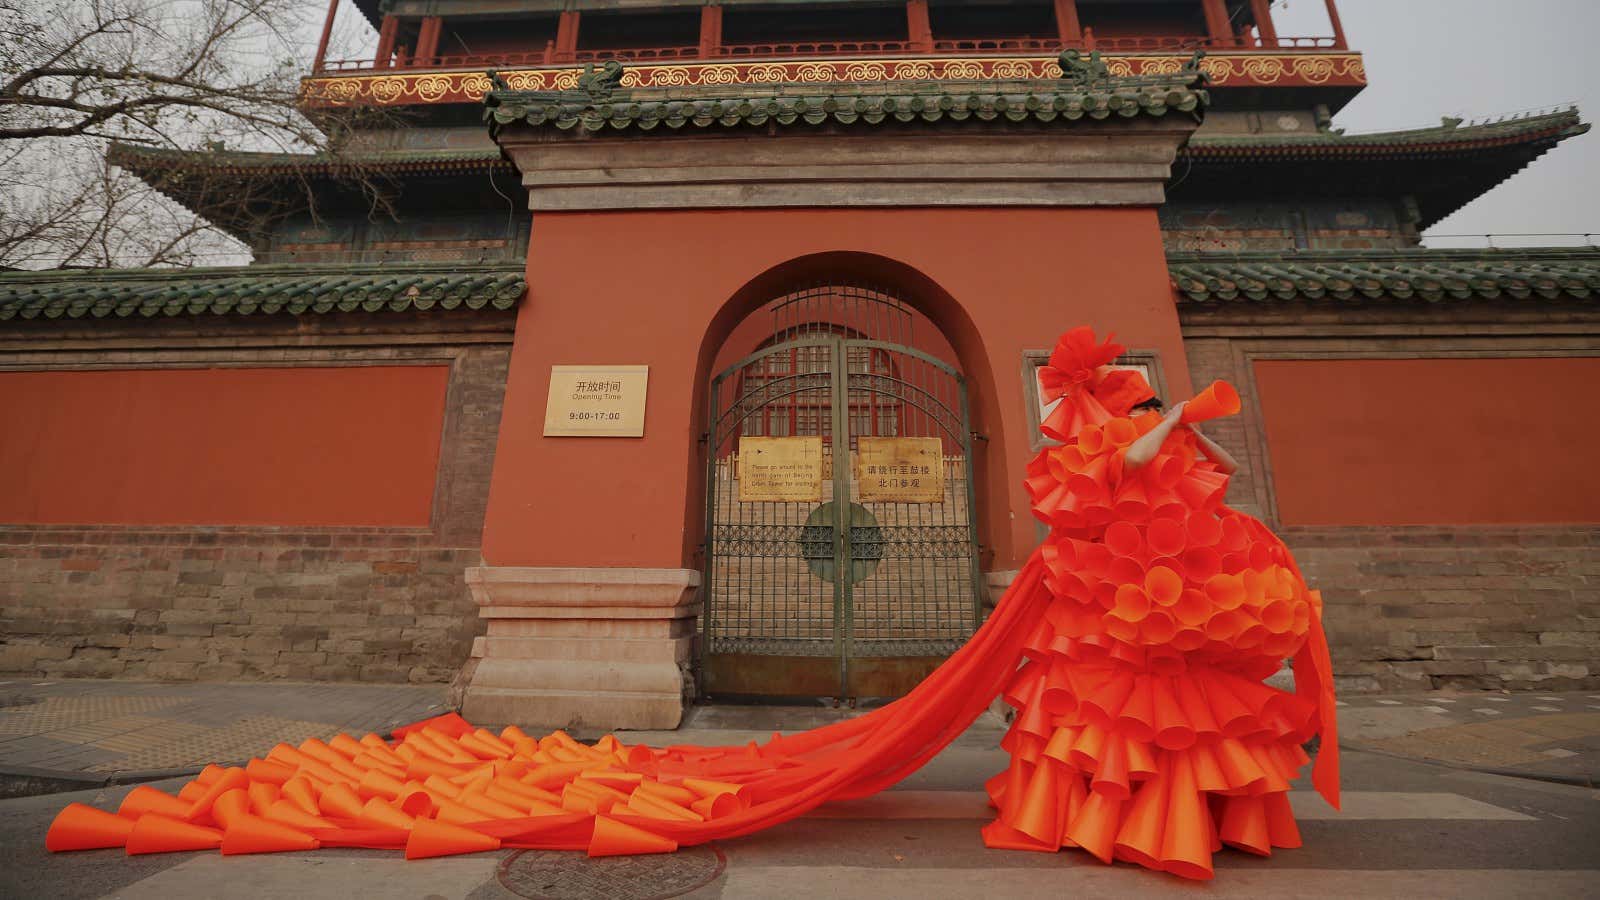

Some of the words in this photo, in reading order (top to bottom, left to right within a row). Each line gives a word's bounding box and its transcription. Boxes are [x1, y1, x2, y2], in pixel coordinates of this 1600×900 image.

[576, 381, 621, 393] 开放时间
[569, 412, 620, 420] 9:00-17:00
[868, 465, 930, 475] 请绕行至鼓楼
[879, 479, 921, 488] 北门参观
